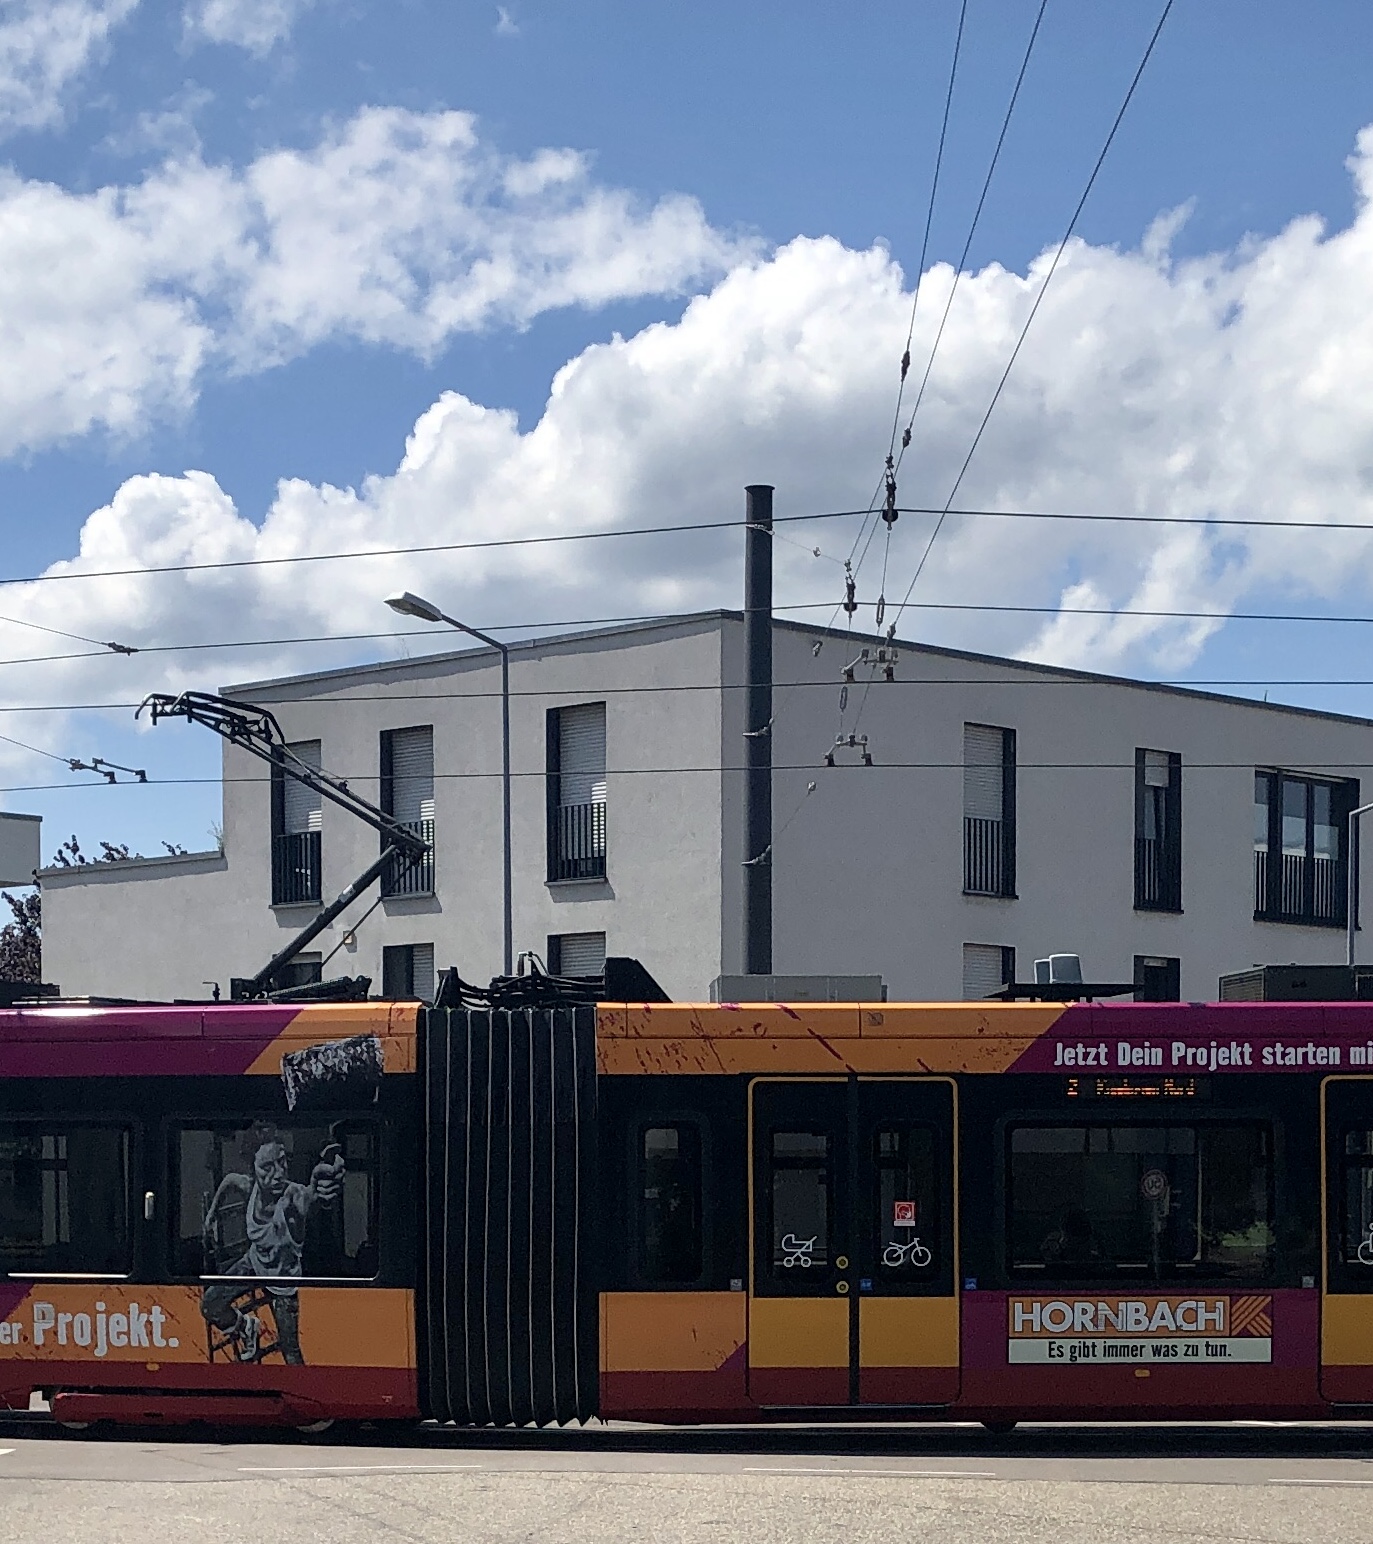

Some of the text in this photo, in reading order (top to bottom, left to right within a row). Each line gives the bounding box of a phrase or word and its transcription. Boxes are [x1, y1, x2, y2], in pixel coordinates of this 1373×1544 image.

[1054, 1042, 1109, 1066] Jetzt
[1117, 1041, 1163, 1066] Dein
[1171, 1041, 1253, 1072] Projekt
[1262, 1042, 1341, 1066] starten
[33, 1301, 180, 1357] Projekt.
[1014, 1301, 1224, 1332] HORNBACH
[1048, 1340, 1232, 1362] Es gibt immer was zu tun.
